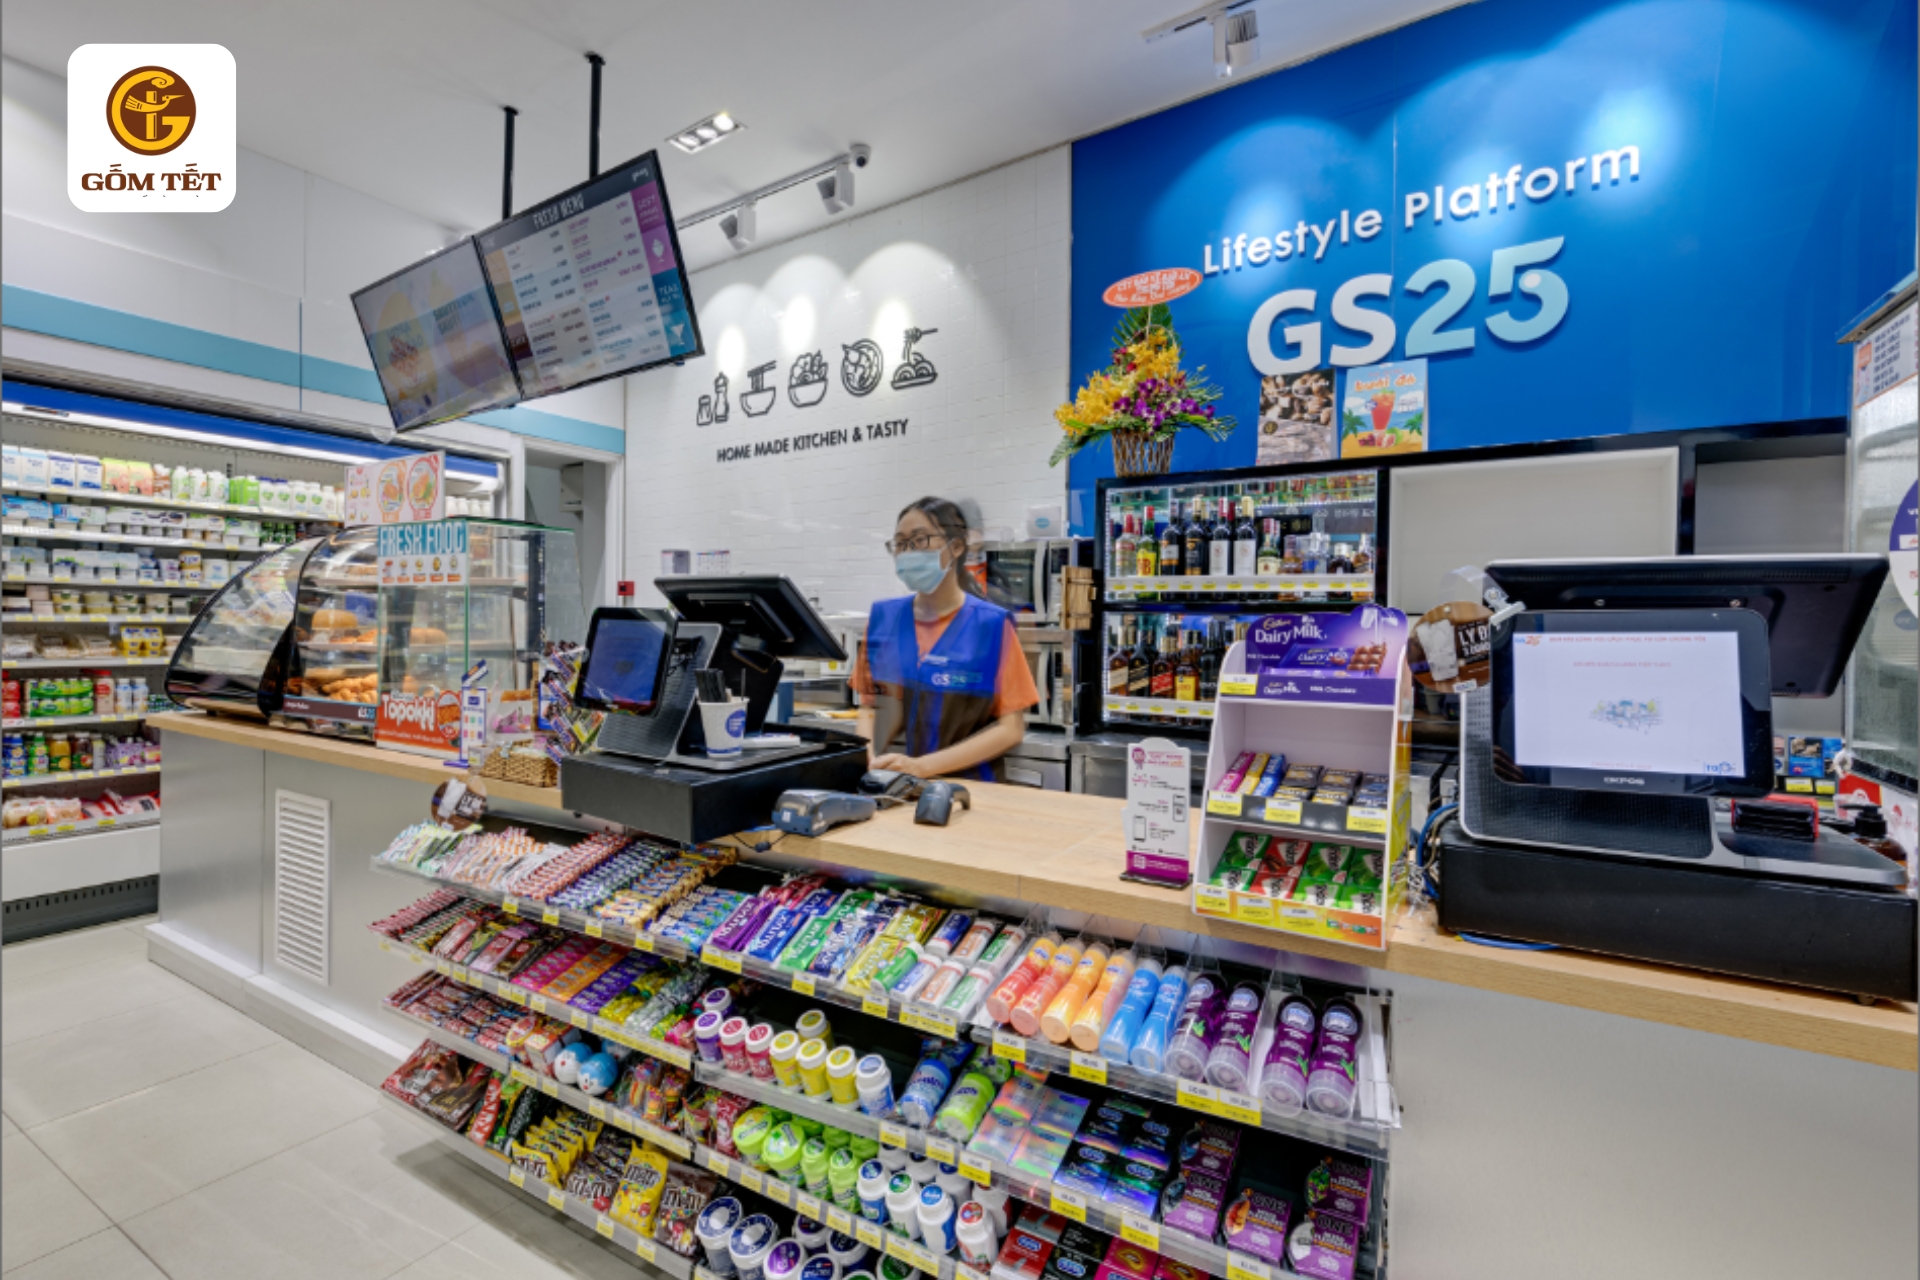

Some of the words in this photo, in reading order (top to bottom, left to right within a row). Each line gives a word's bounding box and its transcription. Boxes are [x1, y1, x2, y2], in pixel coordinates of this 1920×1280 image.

[1204, 209, 1382, 274] Lifestyle
[1405, 145, 1641, 228] Platform
[1247, 236, 1569, 377] GS25
[716, 445, 751, 463] HOME
[754, 437, 789, 457] MADE
[793, 429, 847, 452] KITCHEN
[852, 426, 862, 442] &
[866, 418, 909, 440] TASTY
[380, 524, 423, 557] FRESH
[1255, 629, 1292, 645] Dairy
[1293, 625, 1323, 640] Milk
[1252, 1193, 1287, 1214] ONE
[1317, 1216, 1354, 1236] ONE
